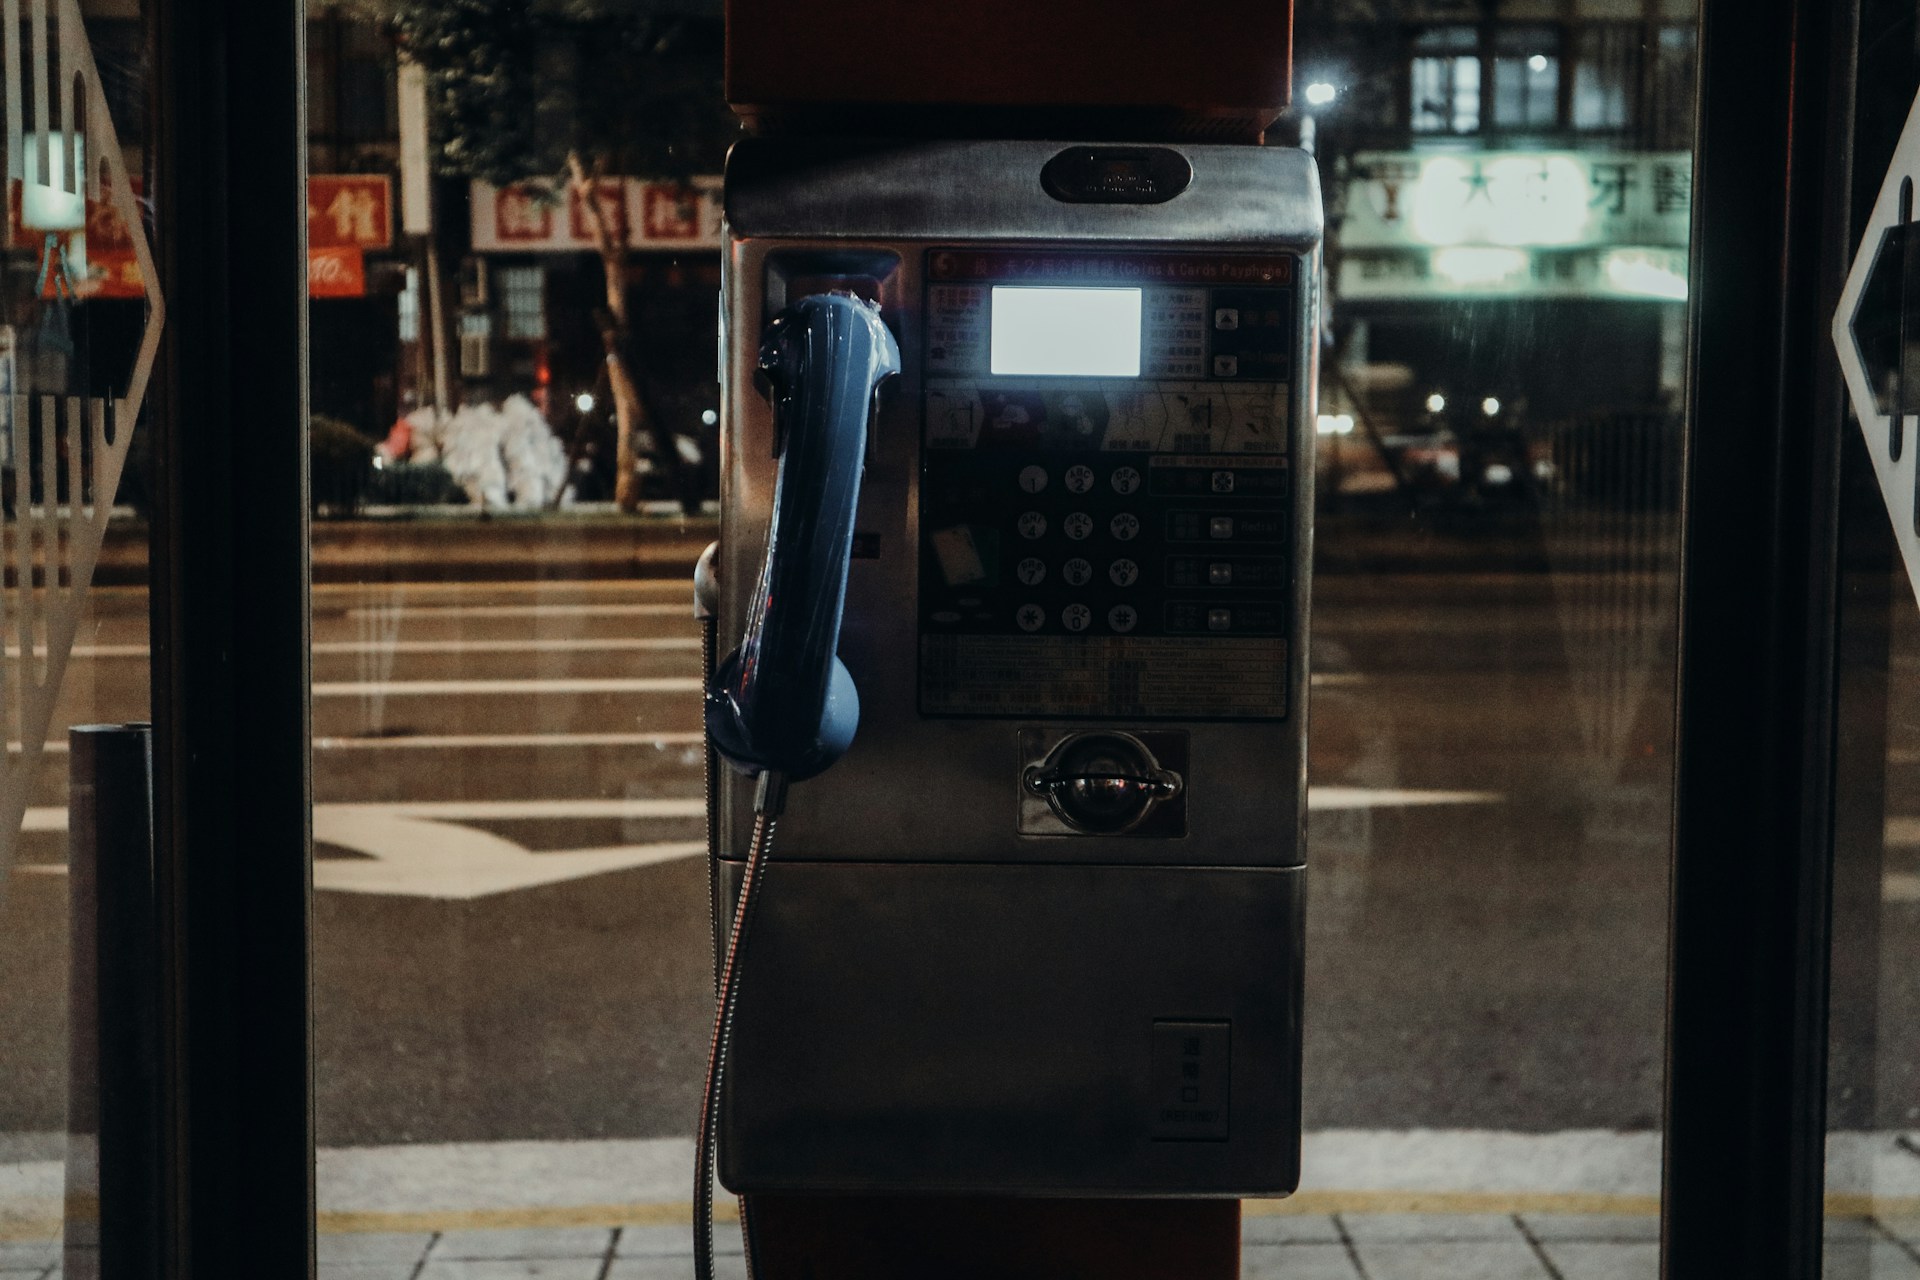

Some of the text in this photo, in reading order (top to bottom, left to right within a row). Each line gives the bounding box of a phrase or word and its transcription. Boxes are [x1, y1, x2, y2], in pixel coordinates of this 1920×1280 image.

[1179, 263, 1217, 277] Cards
[1069, 467, 1091, 479] ABC
[1115, 469, 1138, 481] DEF
[1030, 479, 1037, 493] 1
[1074, 479, 1084, 492] 2
[1119, 480, 1130, 493] 3
[1022, 514, 1042, 525] GHI
[1069, 514, 1090, 526] JKL
[1113, 516, 1137, 528] MNO
[1241, 519, 1278, 532] Redial
[1027, 525, 1036, 537] 4
[1074, 525, 1083, 538] 5
[1119, 526, 1129, 539] 6
[1021, 560, 1044, 572] PRS
[1067, 561, 1089, 572] TUV
[1113, 561, 1135, 574] WXY
[1027, 571, 1036, 583] 7
[1072, 571, 1082, 584] 8
[1119, 572, 1129, 585] 9
[1071, 617, 1081, 629] 0
